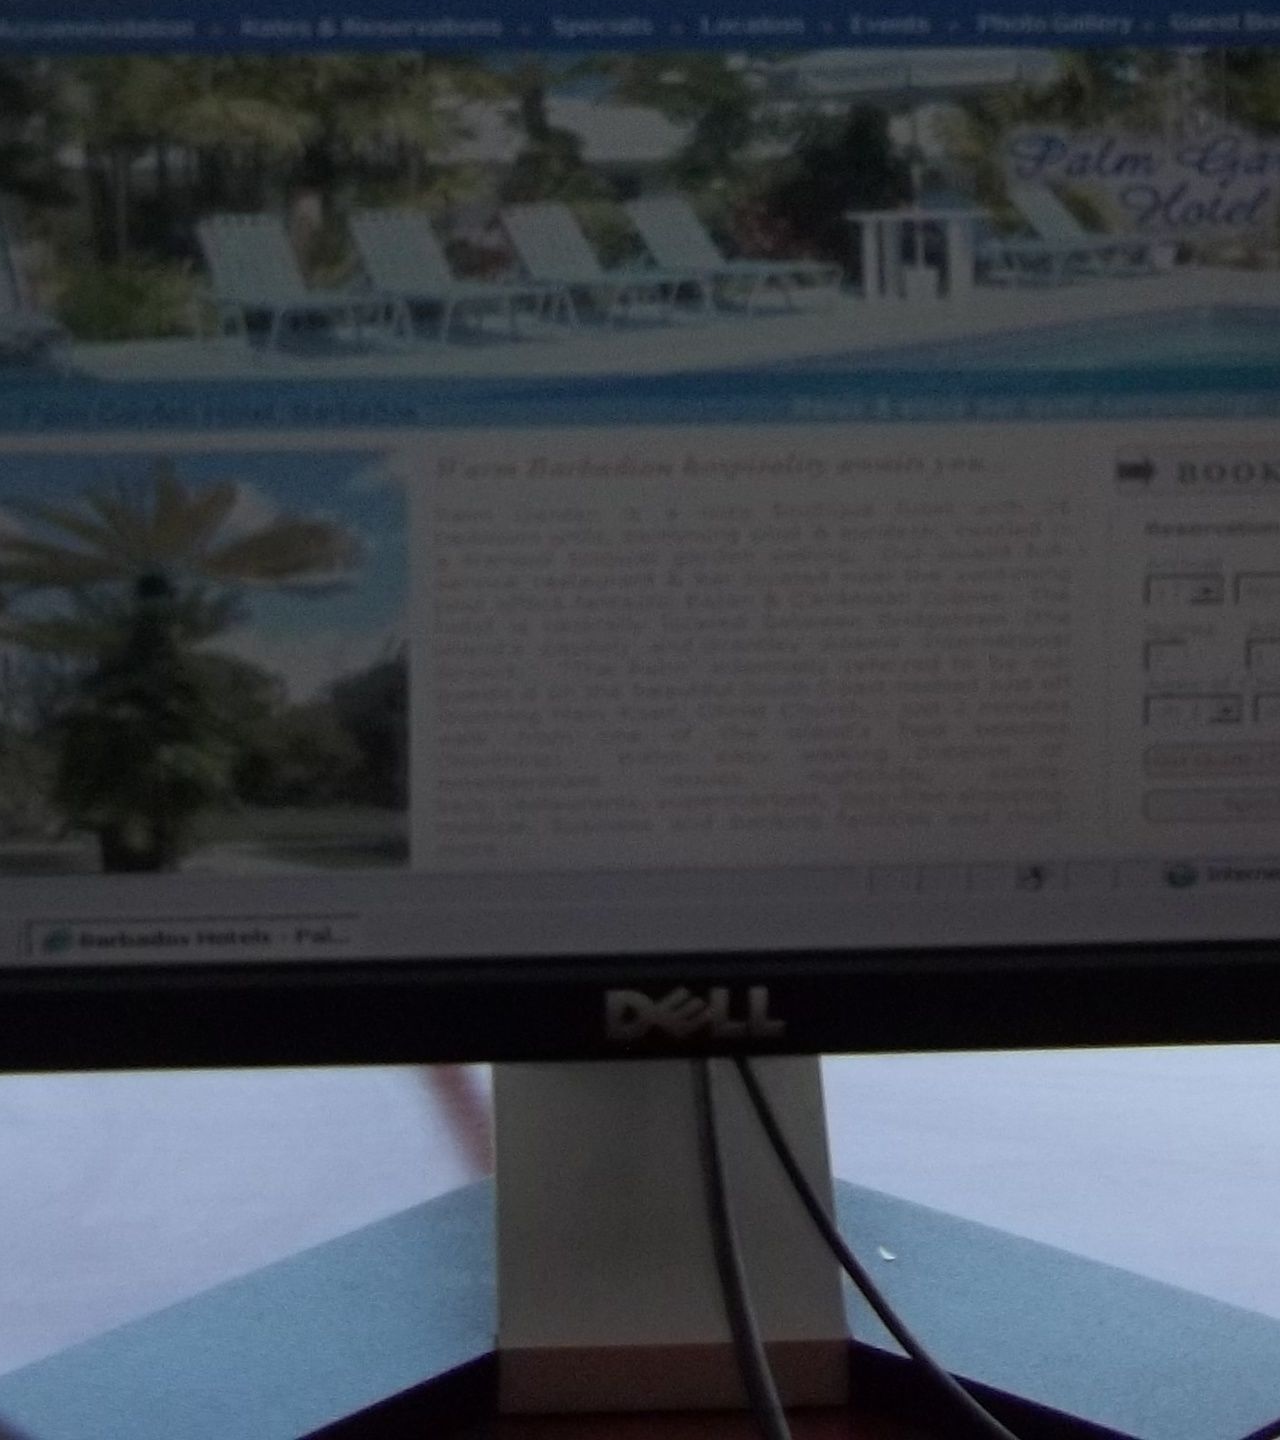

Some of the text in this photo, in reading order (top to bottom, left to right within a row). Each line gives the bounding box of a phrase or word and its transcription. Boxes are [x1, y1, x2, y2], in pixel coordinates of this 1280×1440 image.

[1013, 132, 1155, 177] Palm
[1120, 180, 1270, 228] Hotel
[604, 982, 788, 1041] DELL
